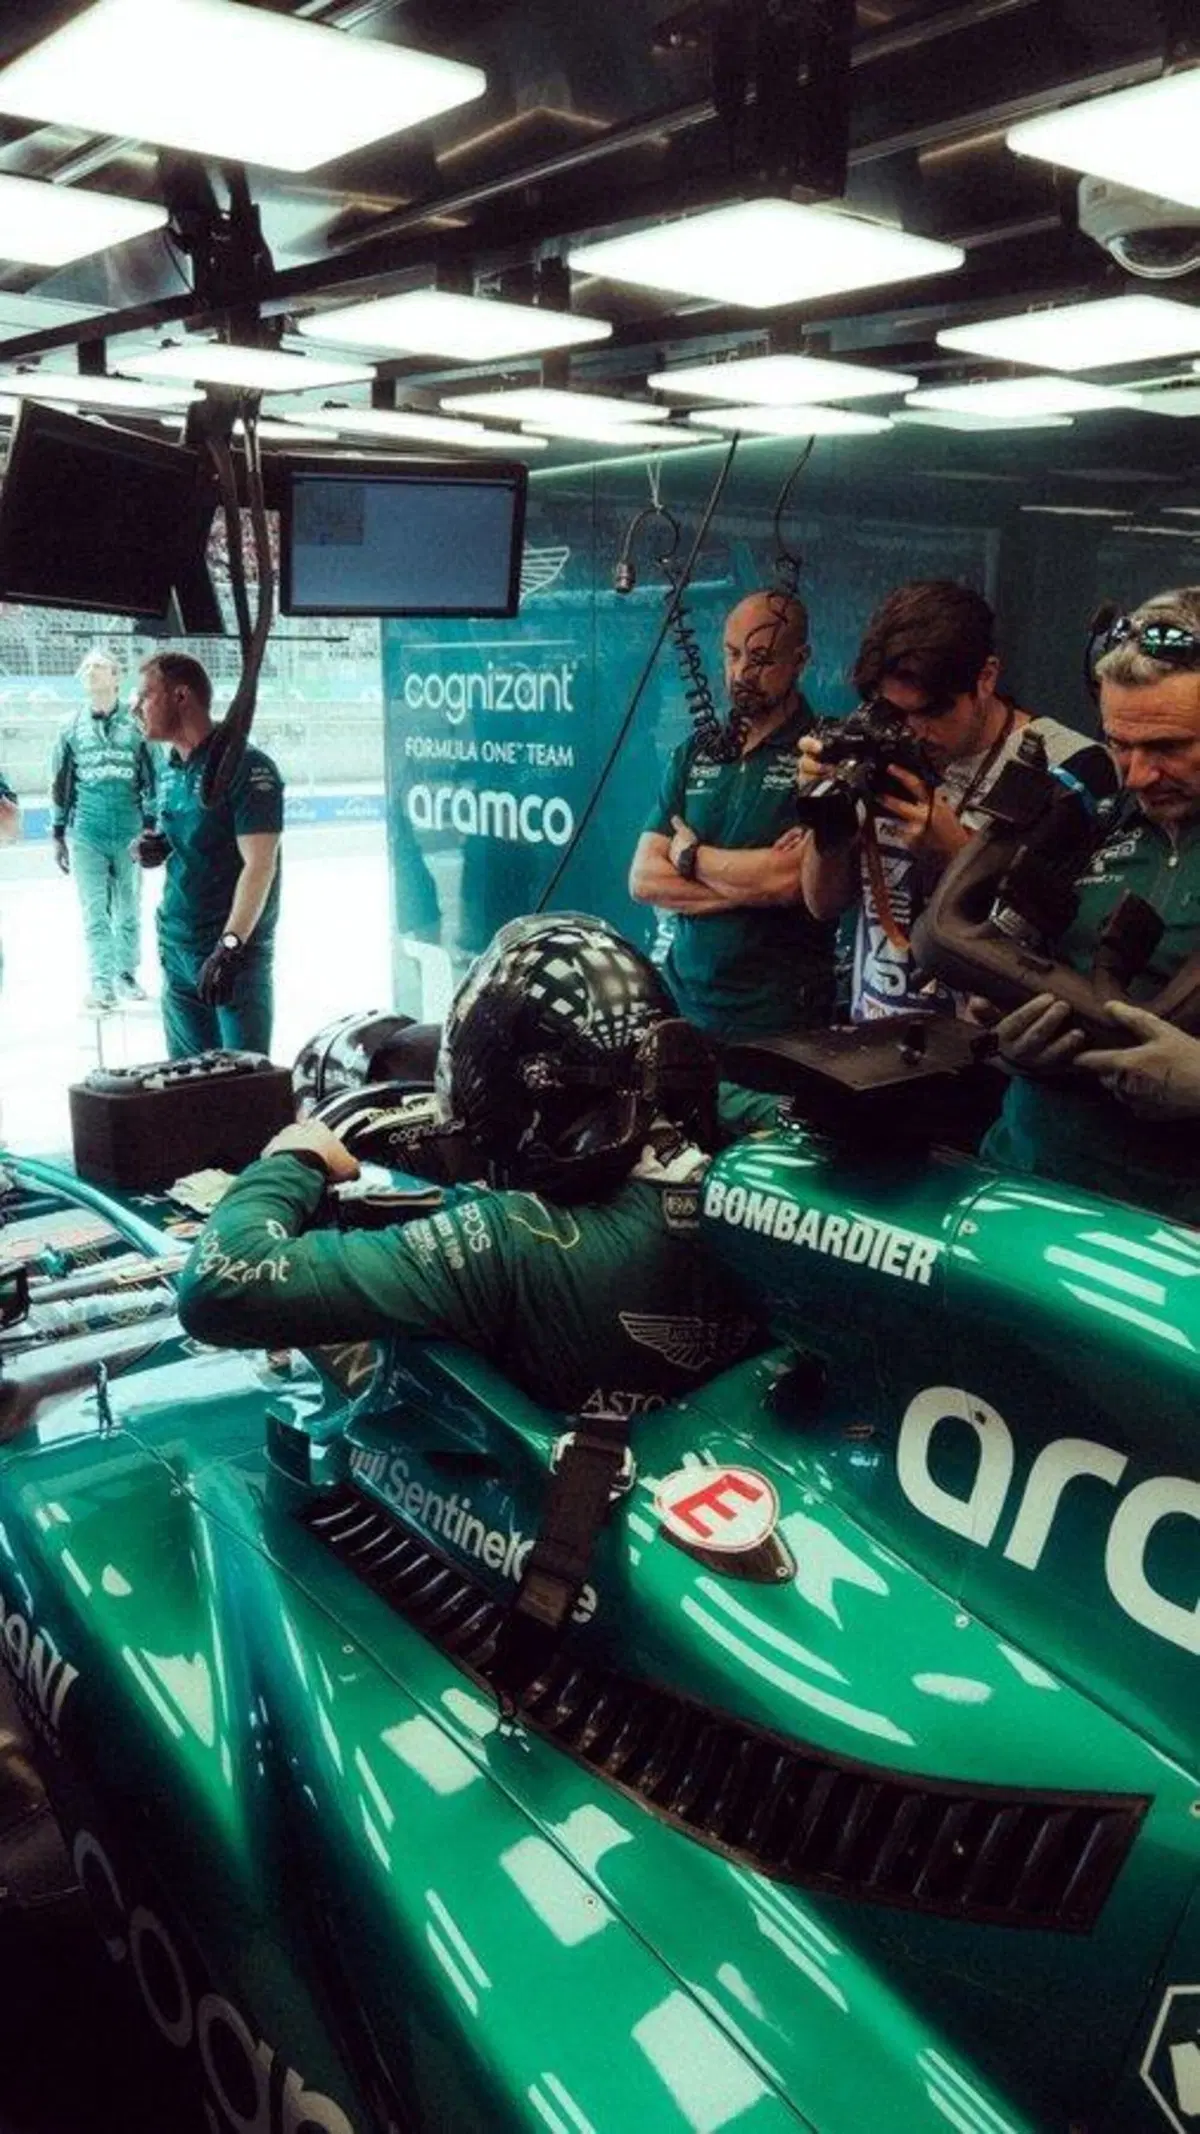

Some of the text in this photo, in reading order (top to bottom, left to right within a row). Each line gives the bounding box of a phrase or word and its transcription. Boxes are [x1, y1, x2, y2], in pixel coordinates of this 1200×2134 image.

[404, 662, 575, 724] cognizant
[404, 736, 476, 762] FORMULA
[526, 743, 575, 768] TEAM
[408, 784, 574, 845] aramco
[703, 1180, 938, 1286] BOMBARDIER
[668, 1473, 765, 1540] E
[0, 1593, 80, 1730] ONI
